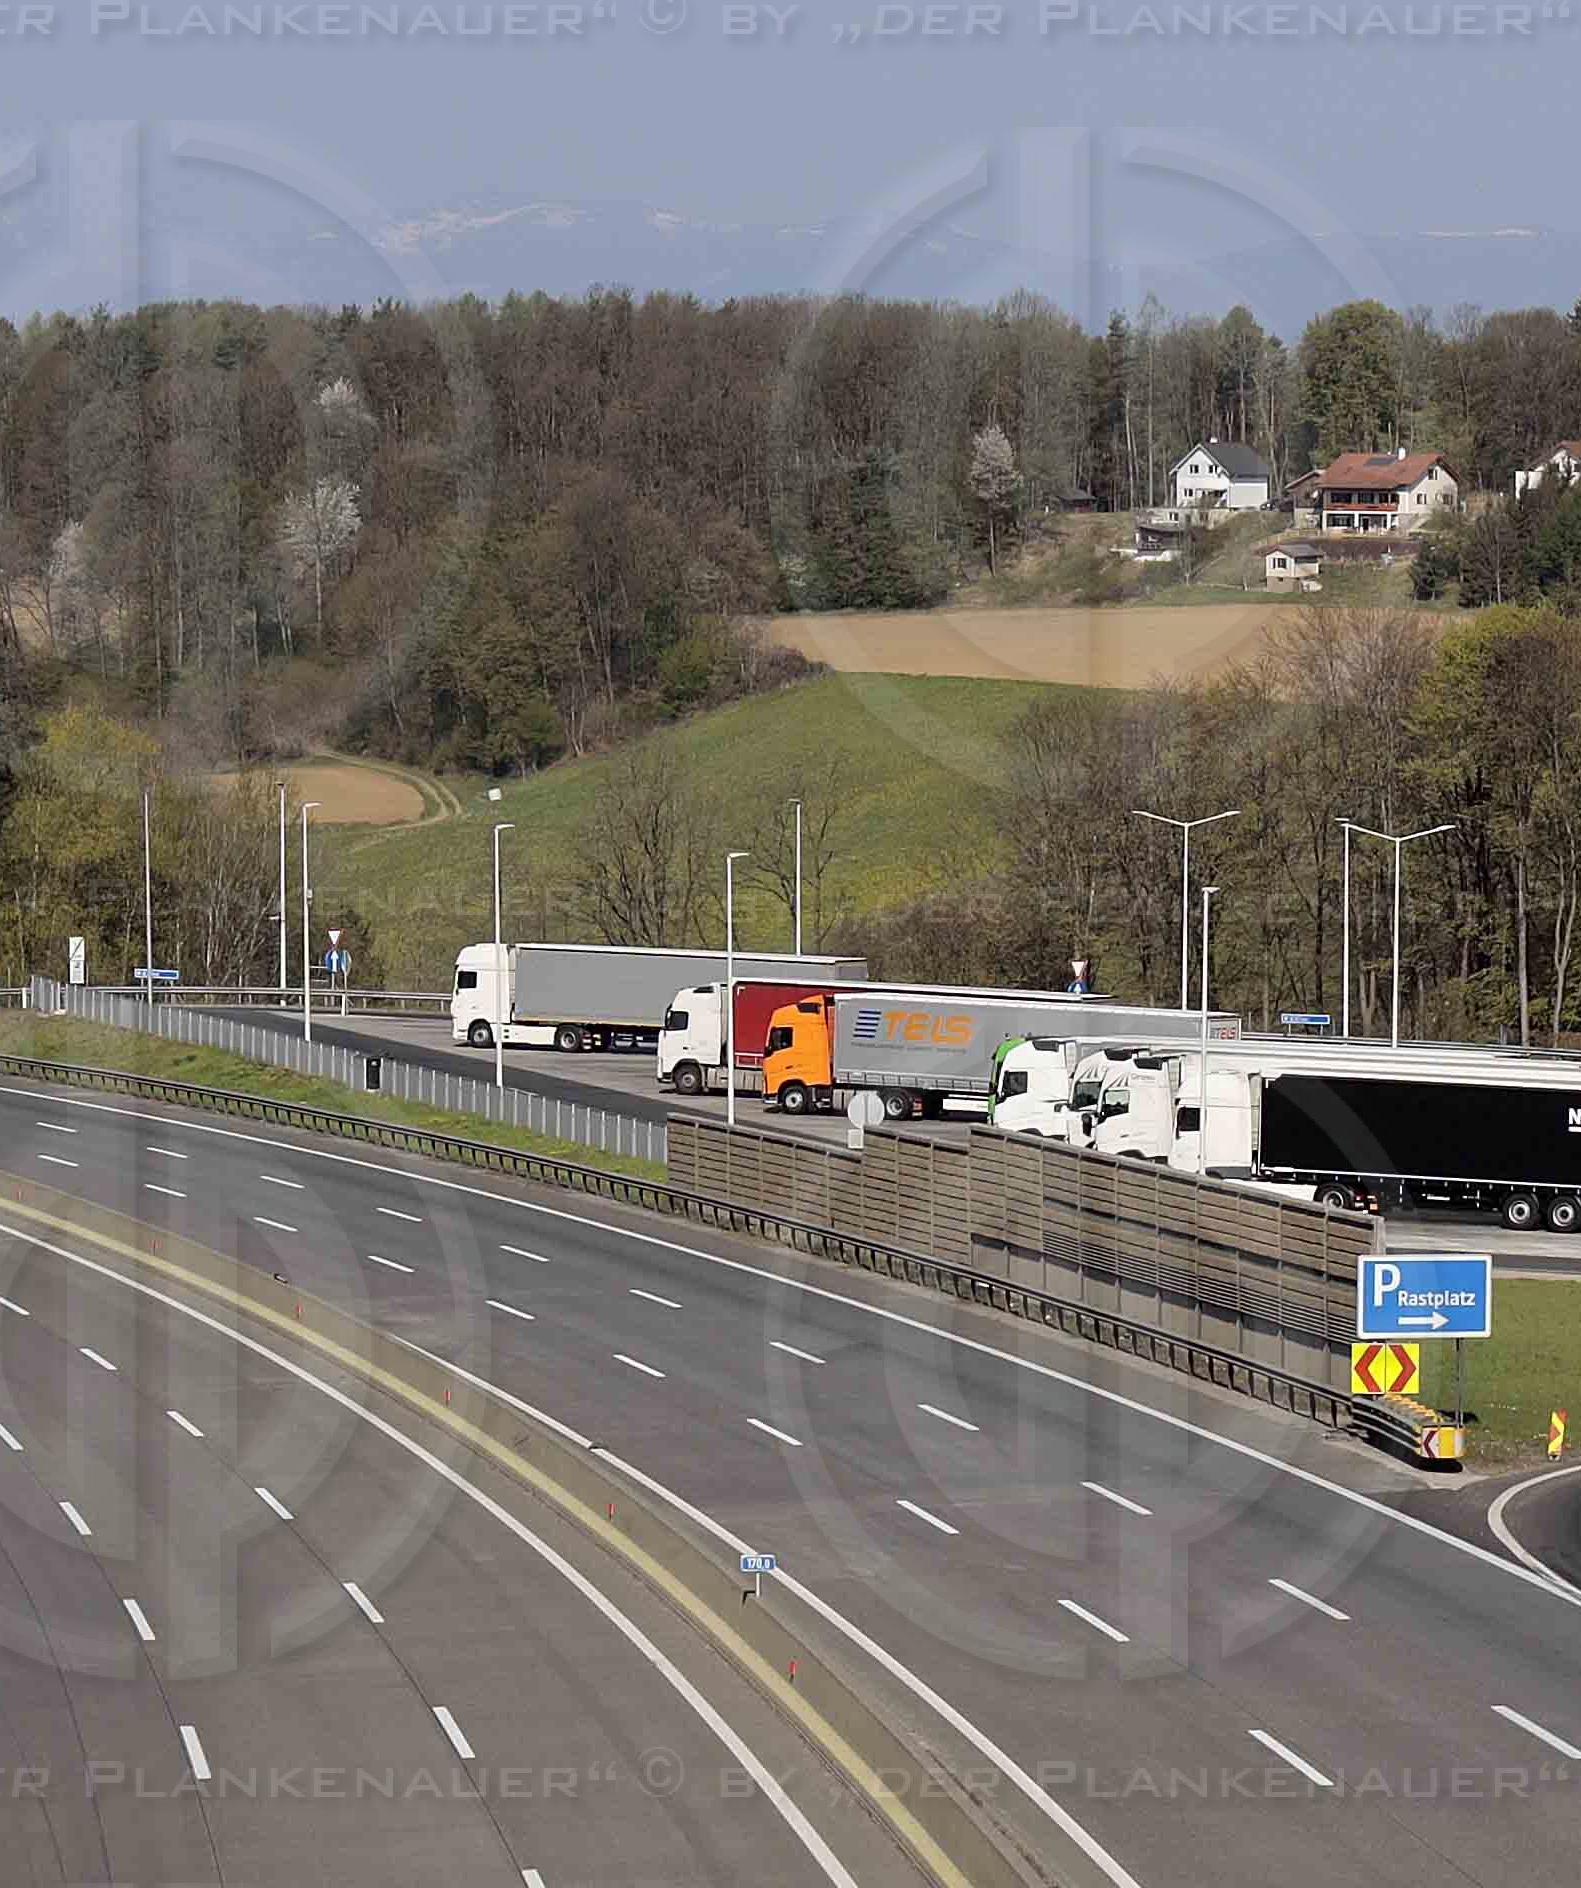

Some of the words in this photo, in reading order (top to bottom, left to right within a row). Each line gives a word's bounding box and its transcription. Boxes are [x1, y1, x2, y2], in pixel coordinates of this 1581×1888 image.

[883, 1010, 975, 1046] TELS
[1374, 1263, 1401, 1307] P
[1399, 1290, 1475, 1309] Rastplatz
